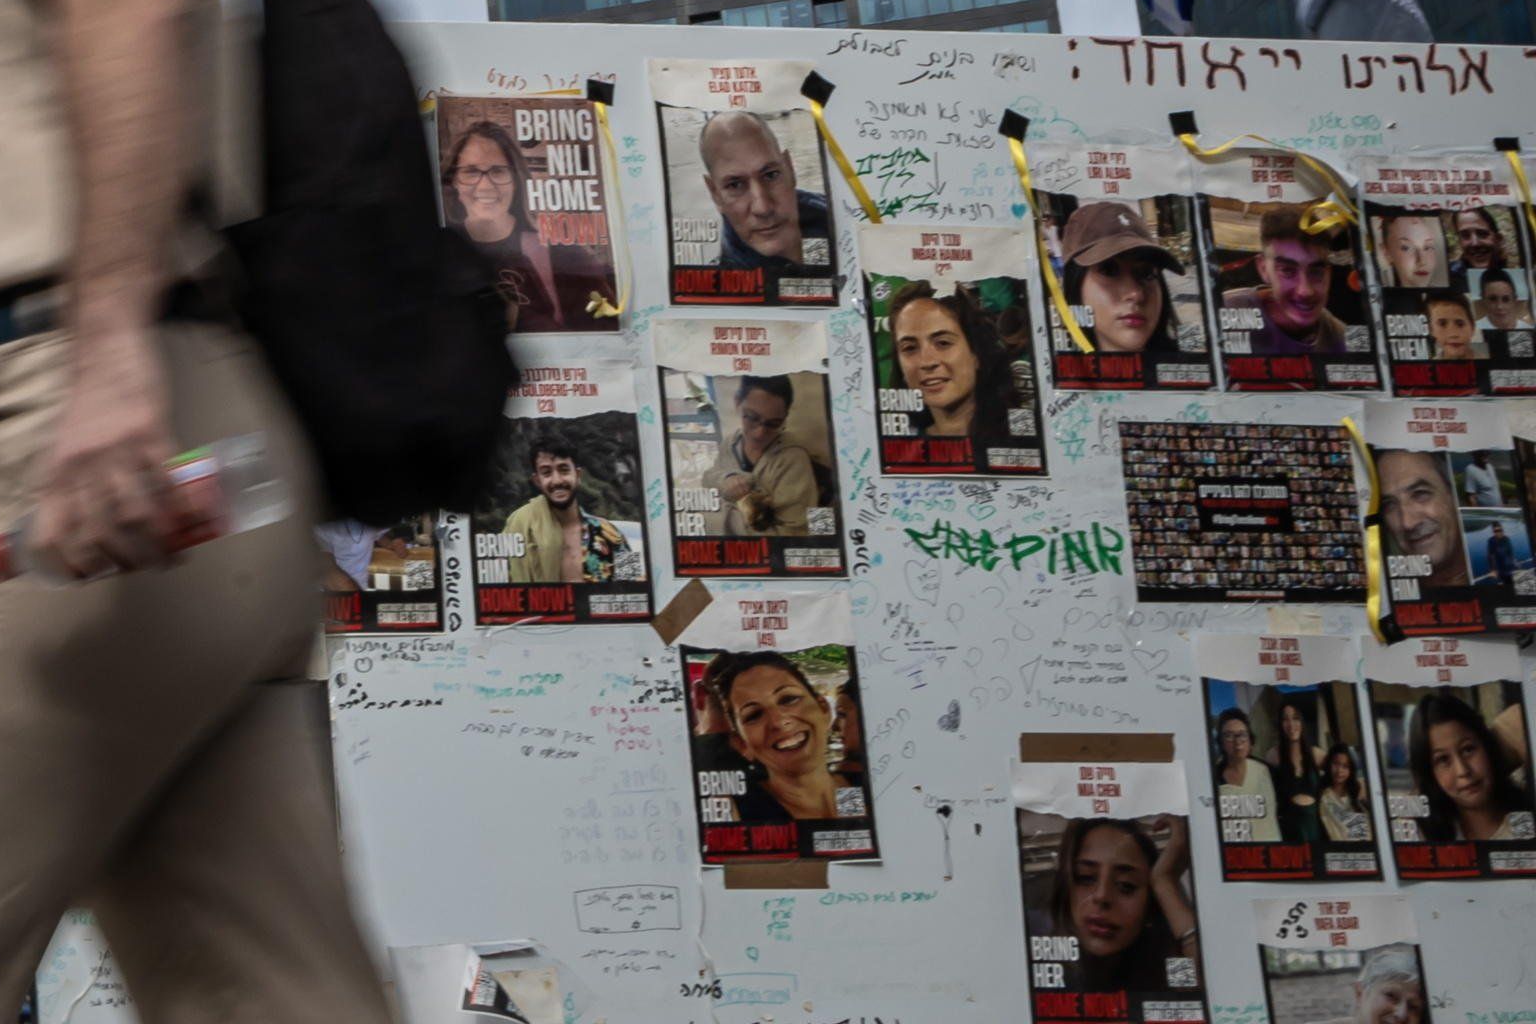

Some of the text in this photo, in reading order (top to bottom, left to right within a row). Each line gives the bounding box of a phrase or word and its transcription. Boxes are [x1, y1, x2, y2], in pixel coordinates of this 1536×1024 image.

[1343, 43, 1493, 95] אלהינו
[515, 109, 593, 141] BRING
[546, 144, 597, 176] NILI
[526, 179, 602, 211] HOME
[536, 212, 609, 246] NOW!
[673, 218, 719, 243] BRING
[1220, 308, 1263, 330] BRING
[1386, 315, 1428, 336] BRING
[1389, 339, 1428, 360] THEM
[522, 384, 598, 397] GOLDBERG-POLIN
[879, 388, 924, 412] BRING
[881, 413, 910, 436] HER
[674, 488, 720, 512] BRING
[676, 513, 706, 536] HER
[476, 533, 525, 558] BRING
[724, 538, 769, 565] NOW!
[477, 560, 509, 584] HIM
[1388, 554, 1432, 576] BRING
[479, 586, 575, 613] HOME NOW!
[698, 771, 746, 796] BRING
[701, 797, 732, 822] HER
[1220, 795, 1266, 818] BRING
[1031, 937, 1079, 961] BRING
[1033, 964, 1066, 988] HER
